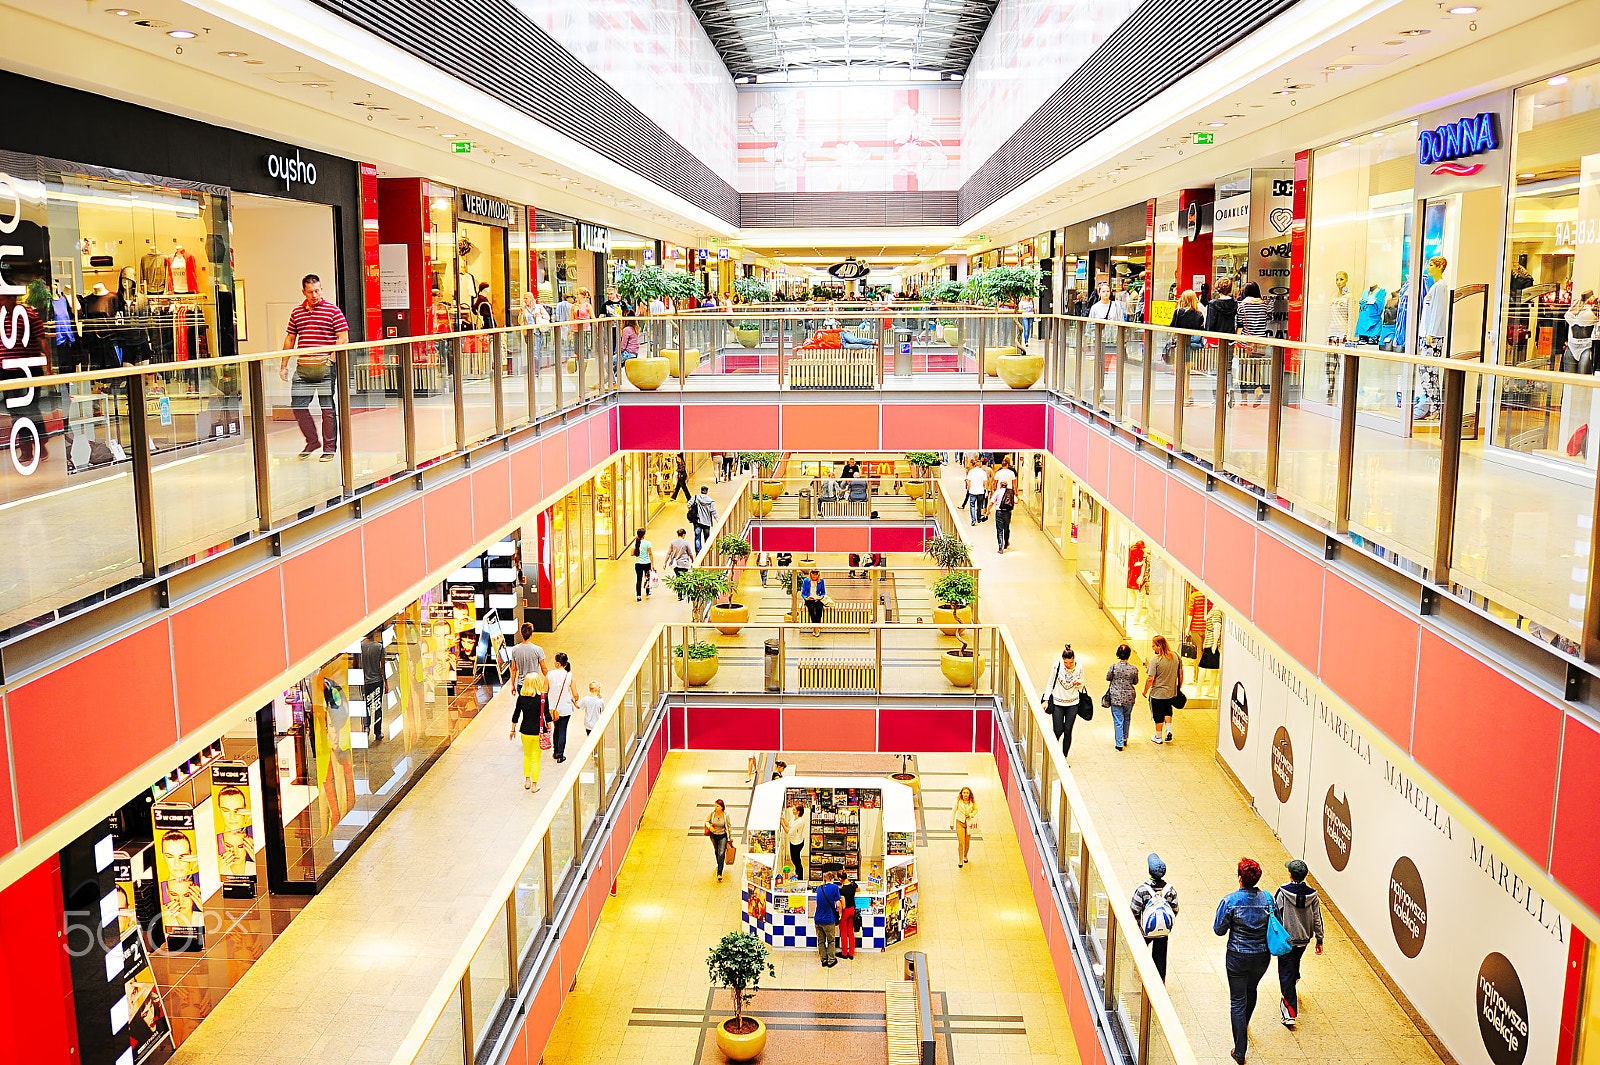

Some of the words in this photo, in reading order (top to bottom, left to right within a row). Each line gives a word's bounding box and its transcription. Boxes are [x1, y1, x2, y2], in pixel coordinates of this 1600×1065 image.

[1420, 112, 1495, 165] DONNA
[267, 149, 317, 191] oysho
[465, 193, 487, 216] VERO
[487, 199, 510, 221] MODA
[1223, 204, 1249, 219] OAKLEY
[1258, 268, 1291, 278] BURTO
[1227, 619, 1262, 662] MARELLA
[1268, 654, 1310, 706] MARELLA
[1319, 701, 1372, 765] MARELLA
[212, 767, 220, 777] 3
[154, 809, 163, 821] 3
[1383, 759, 1453, 841] MARELLA
[1324, 804, 1352, 841] najnowsze
[1326, 817, 1347, 854] kolekcje
[1390, 877, 1427, 924] najnowsze
[1469, 836, 1565, 944] MARELLA
[1393, 893, 1420, 939] kolekcje
[1479, 974, 1528, 1037] najnowsze
[1483, 994, 1519, 1052] kolekcje
